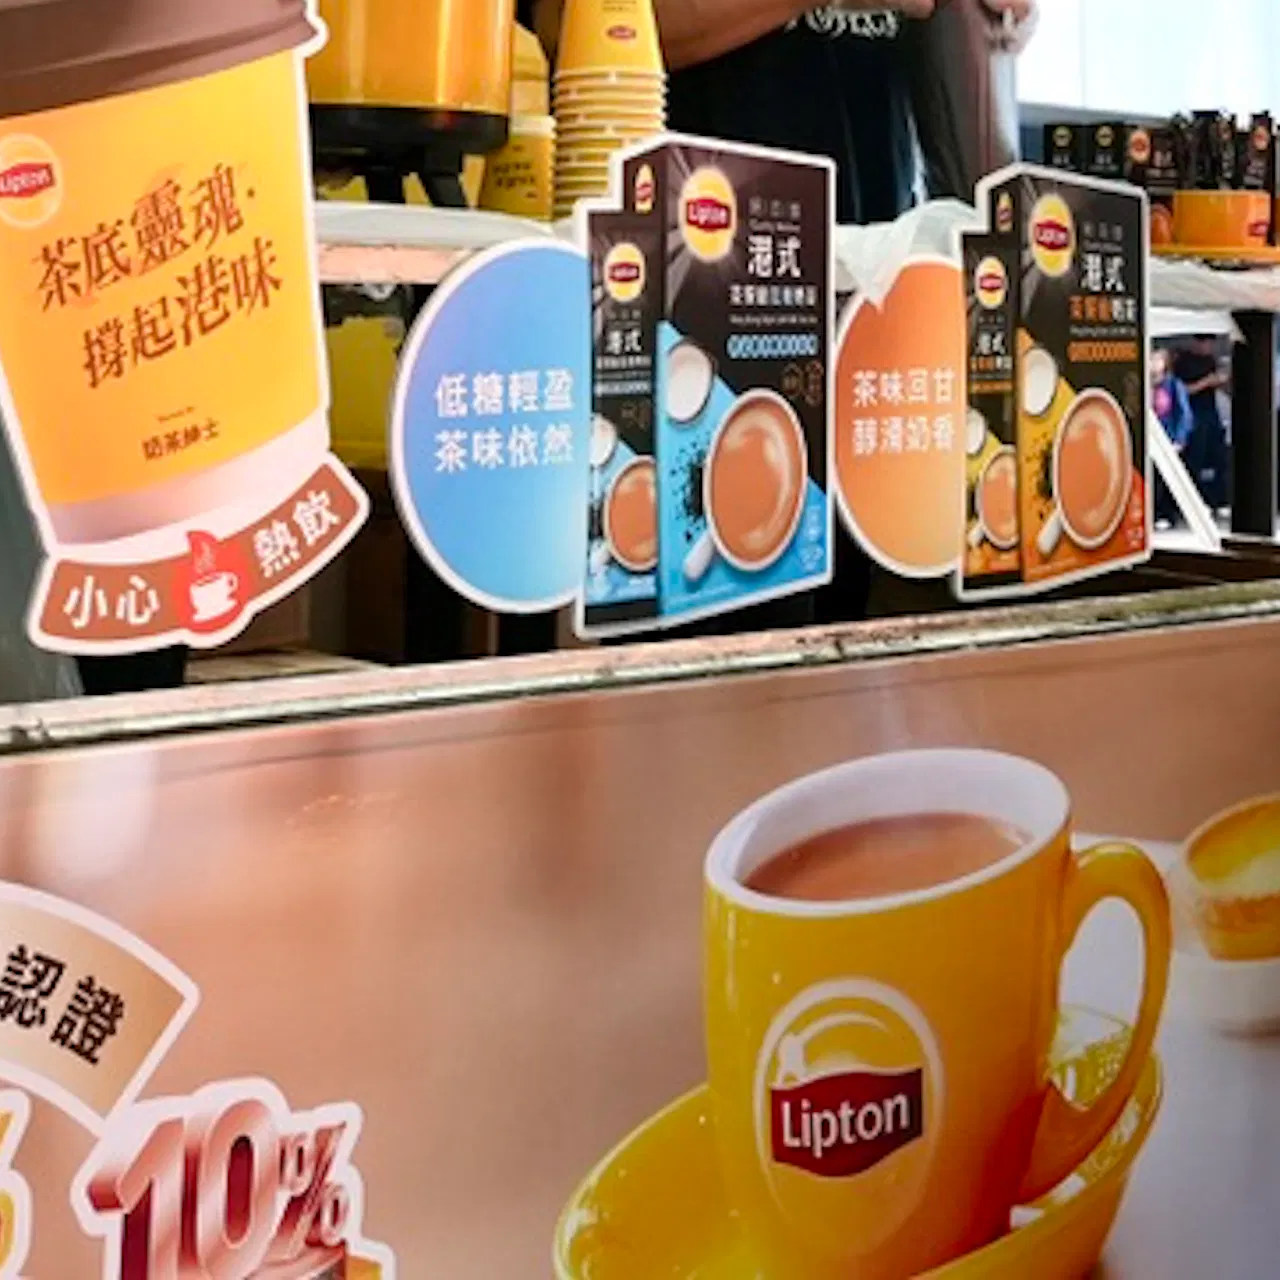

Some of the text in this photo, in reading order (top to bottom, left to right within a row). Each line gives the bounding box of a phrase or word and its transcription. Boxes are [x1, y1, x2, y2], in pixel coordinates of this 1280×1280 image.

[747, 234, 802, 279] 港式
[81, 236, 283, 389] 撐起港味
[433, 368, 575, 419] 低糖輕盈
[851, 369, 957, 409] 茶味回甘
[433, 423, 575, 475] 茶味依然
[63, 488, 342, 629] 小心 熱飲
[780, 1091, 912, 1157] Lipton
[87, 1096, 349, 1280] 10%
